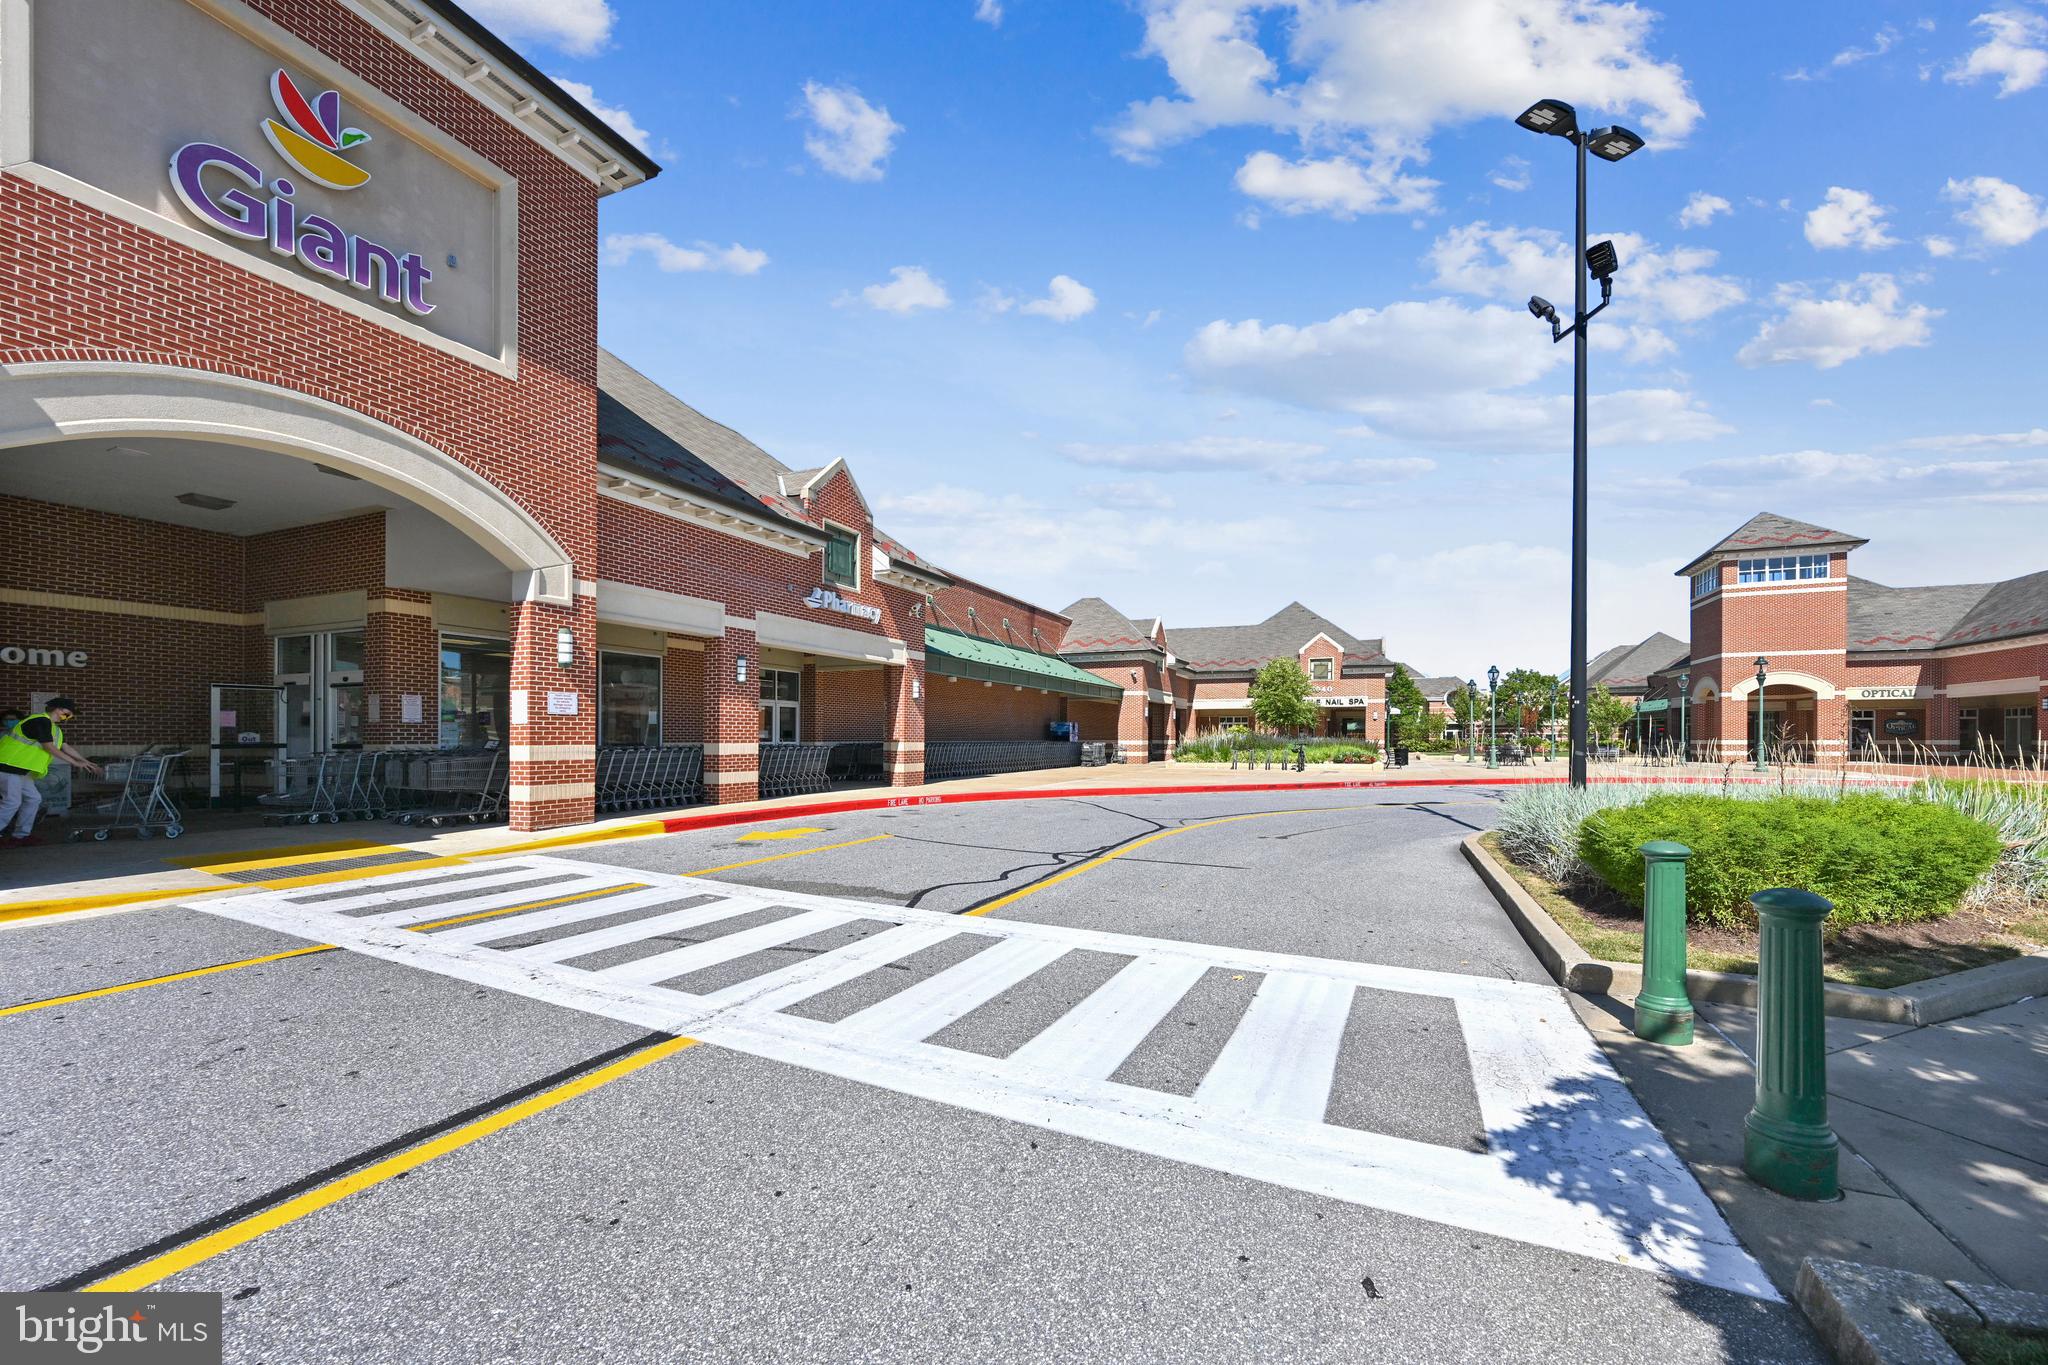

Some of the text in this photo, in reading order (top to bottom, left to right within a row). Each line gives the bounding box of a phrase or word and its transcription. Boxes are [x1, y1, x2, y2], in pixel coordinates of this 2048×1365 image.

[168, 142, 437, 316] Giant
[823, 590, 882, 625] Pharmacy
[1862, 690, 1916, 698] OPTICAL
